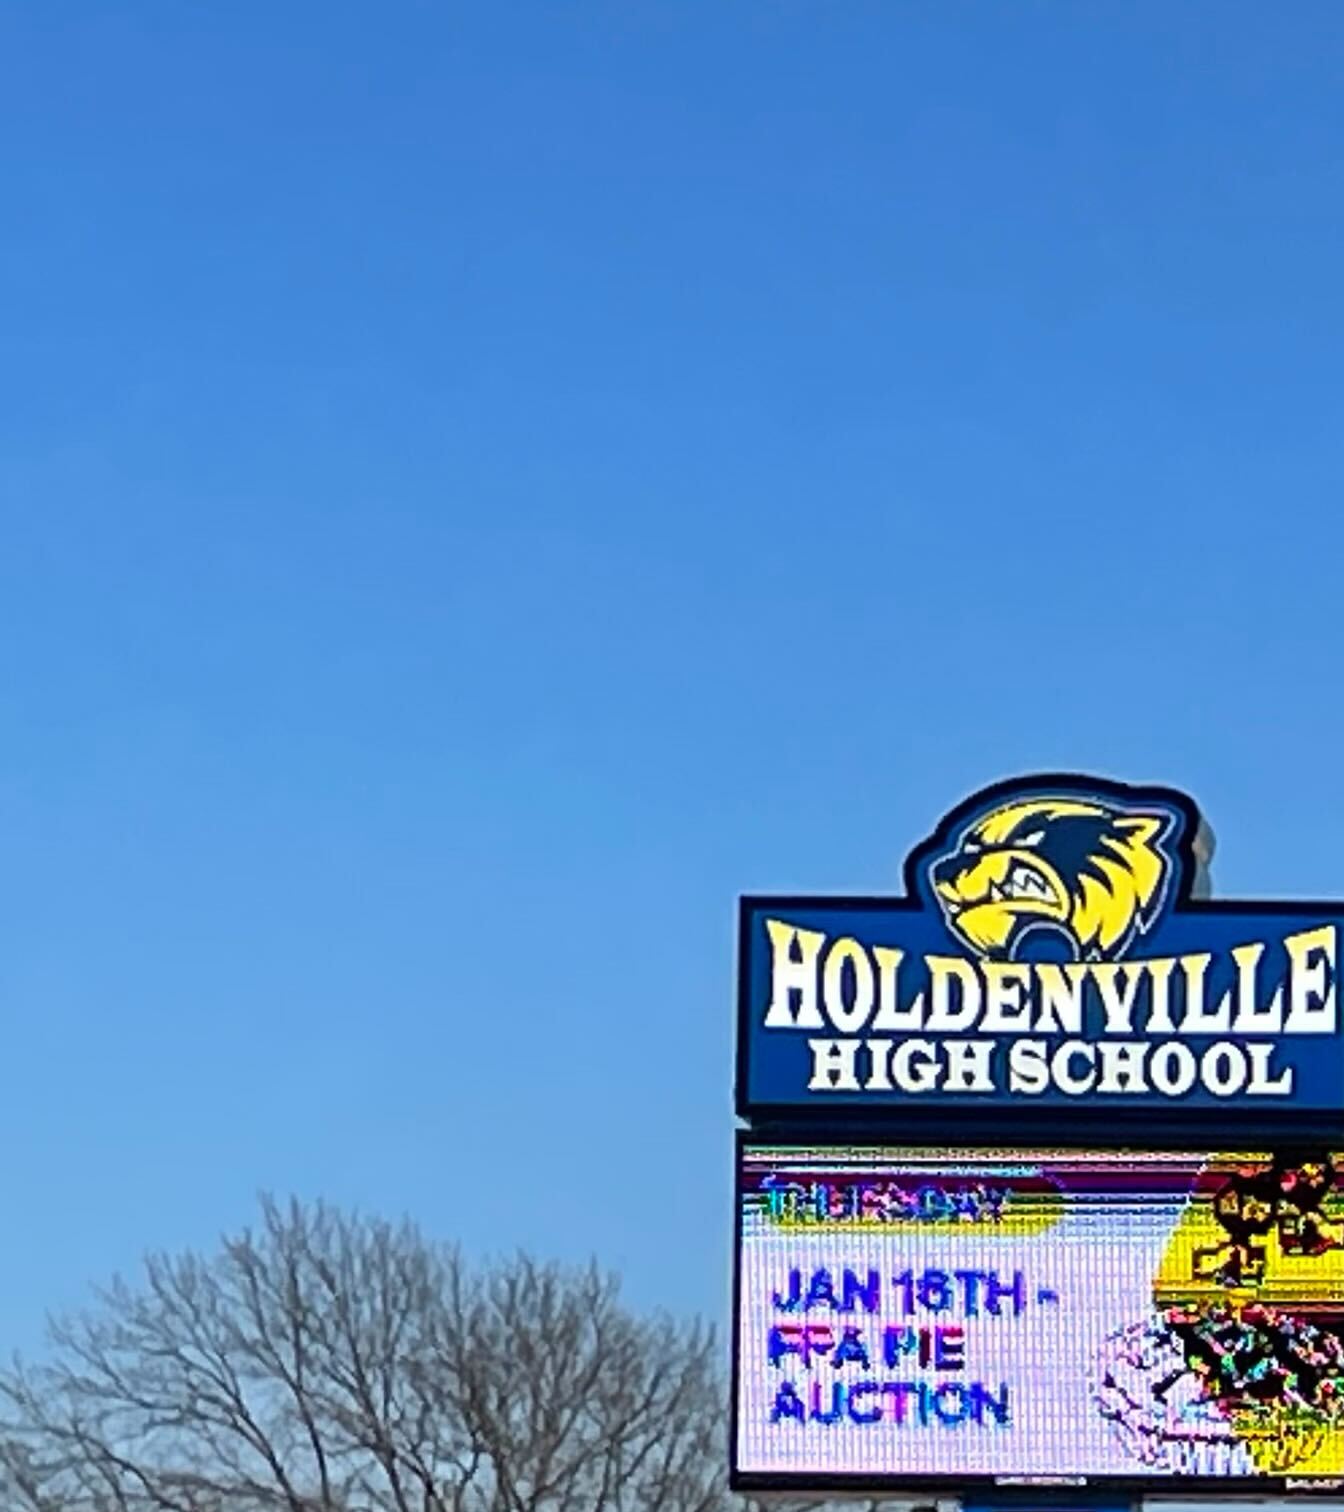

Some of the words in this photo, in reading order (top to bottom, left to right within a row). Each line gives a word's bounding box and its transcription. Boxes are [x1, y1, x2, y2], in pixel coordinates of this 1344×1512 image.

[764, 920, 1336, 1034] HOLDENVILLE
[807, 1038, 996, 1092] HIGH
[1009, 1039, 1293, 1096] SCHOOL
[772, 1268, 881, 1313] JAN
[883, 1324, 965, 1371] PIE
[769, 1380, 1012, 1427] AUCTION
